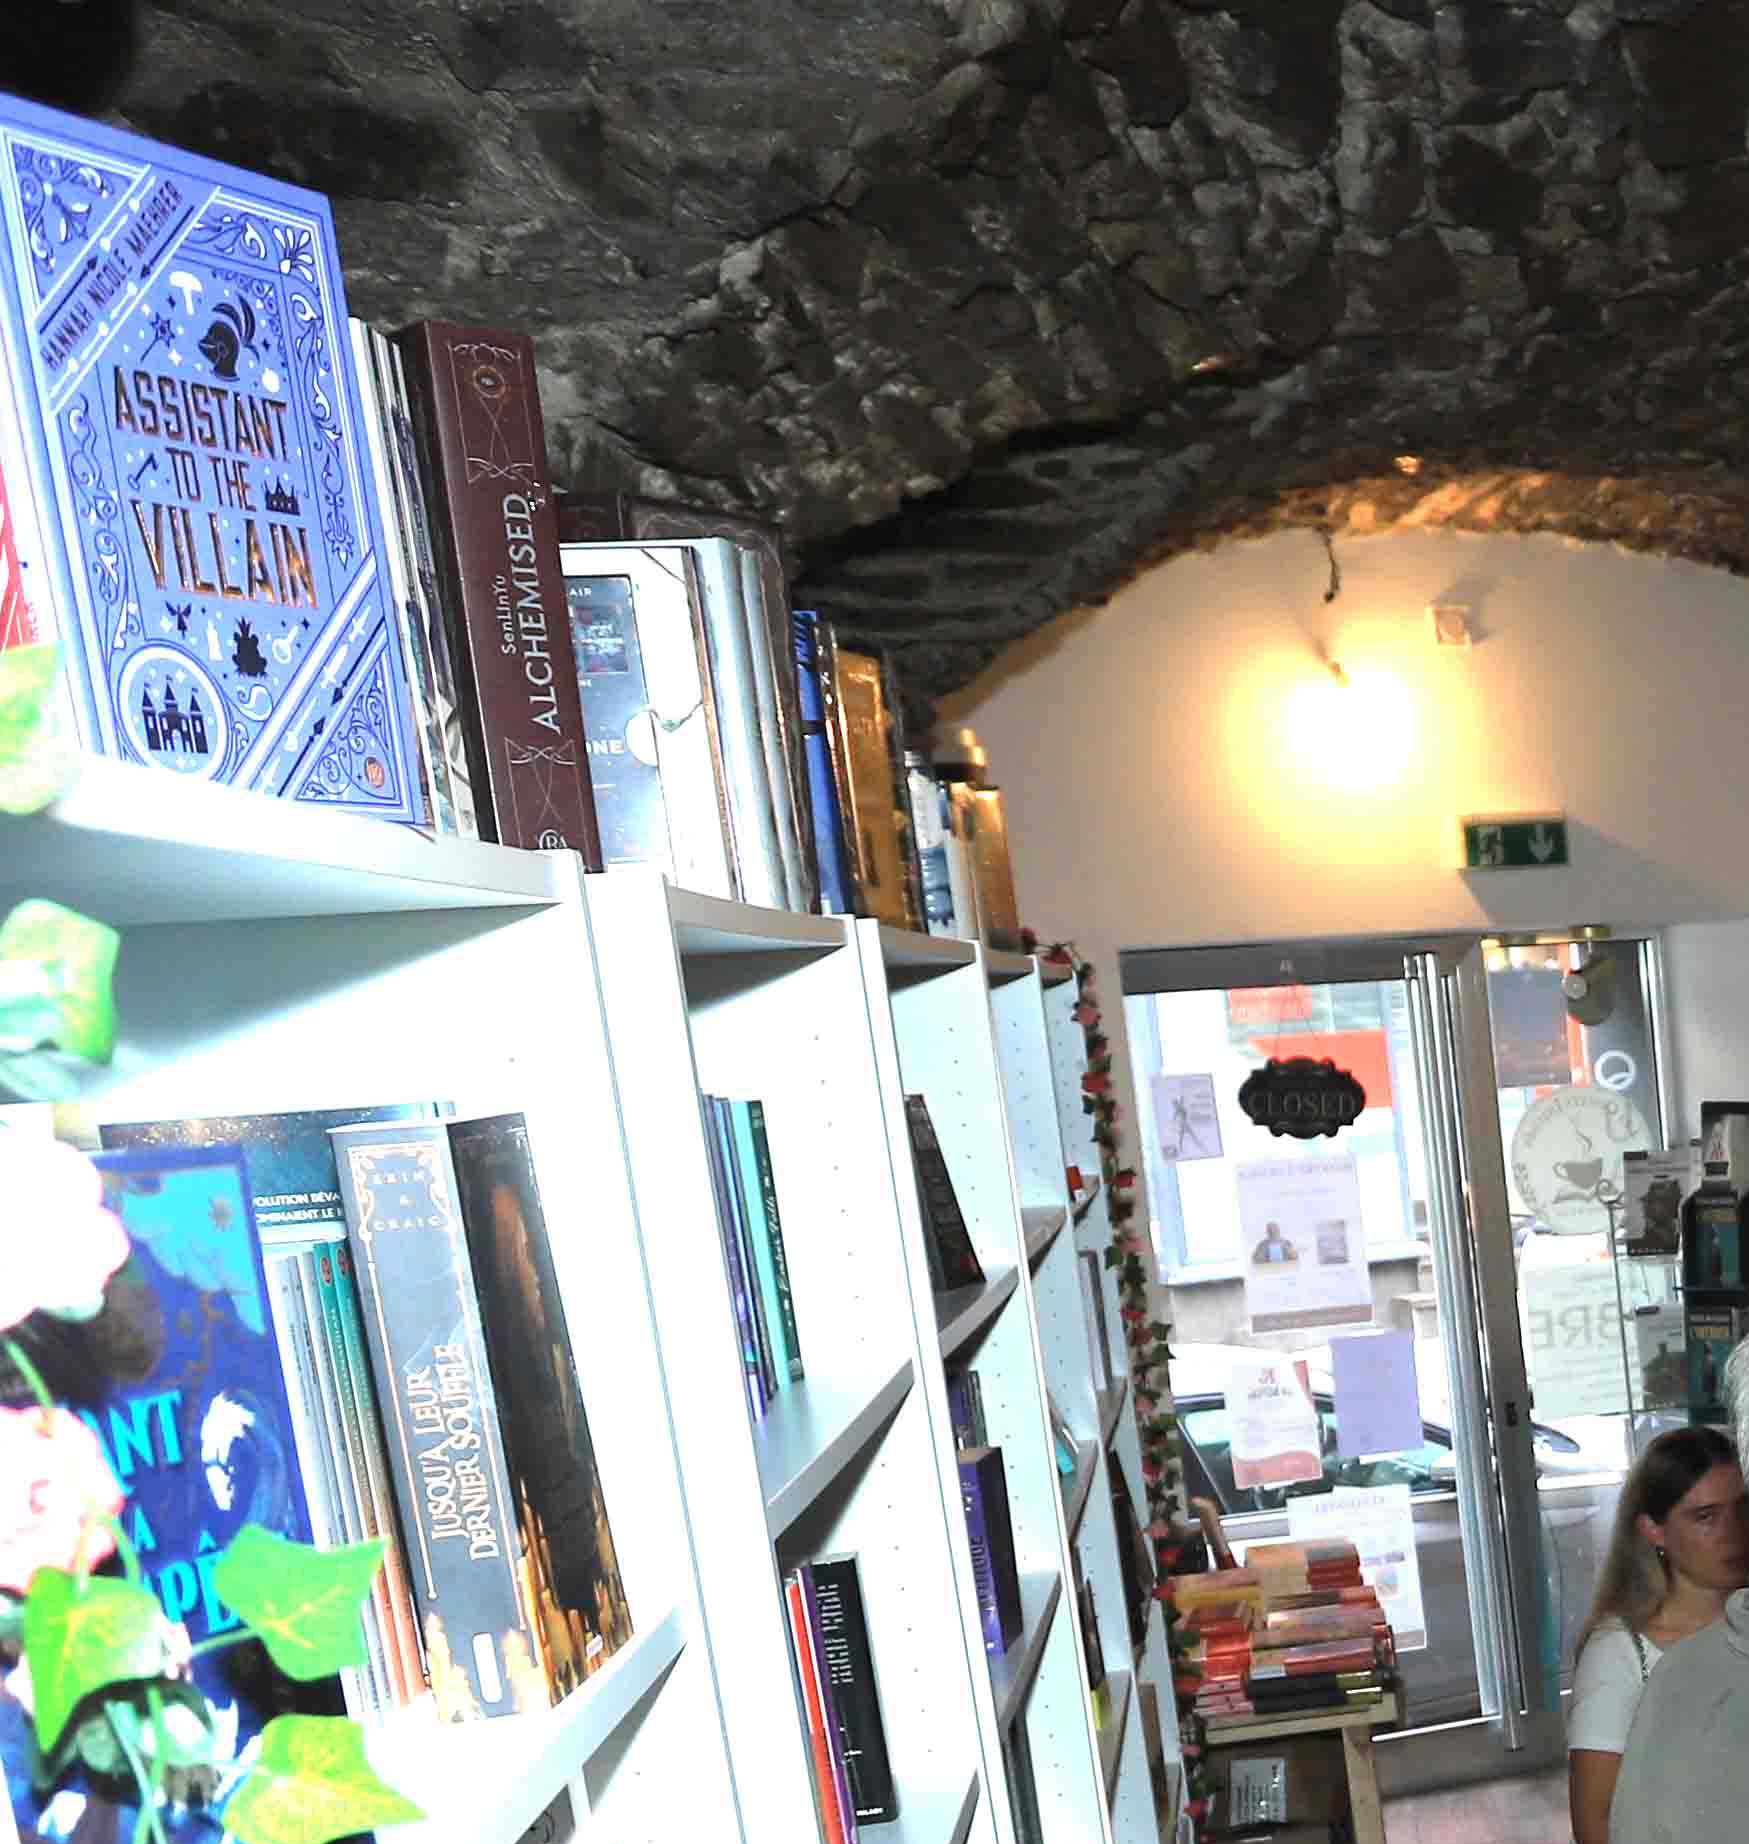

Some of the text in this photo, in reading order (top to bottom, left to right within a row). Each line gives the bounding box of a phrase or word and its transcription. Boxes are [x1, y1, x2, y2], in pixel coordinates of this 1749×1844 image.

[40, 180, 183, 371] HANNAH NICOLE MAEHRER
[113, 365, 288, 462] ASSISTANT
[165, 446, 258, 512] TO THE
[131, 500, 318, 607] VILLAIN
[502, 493, 561, 735] ALCHEMISED
[1250, 1091, 1357, 1119] CLOSED
[404, 1368, 443, 1436] LEUR
[434, 1342, 500, 1561] DERNIER SOUFFLE
